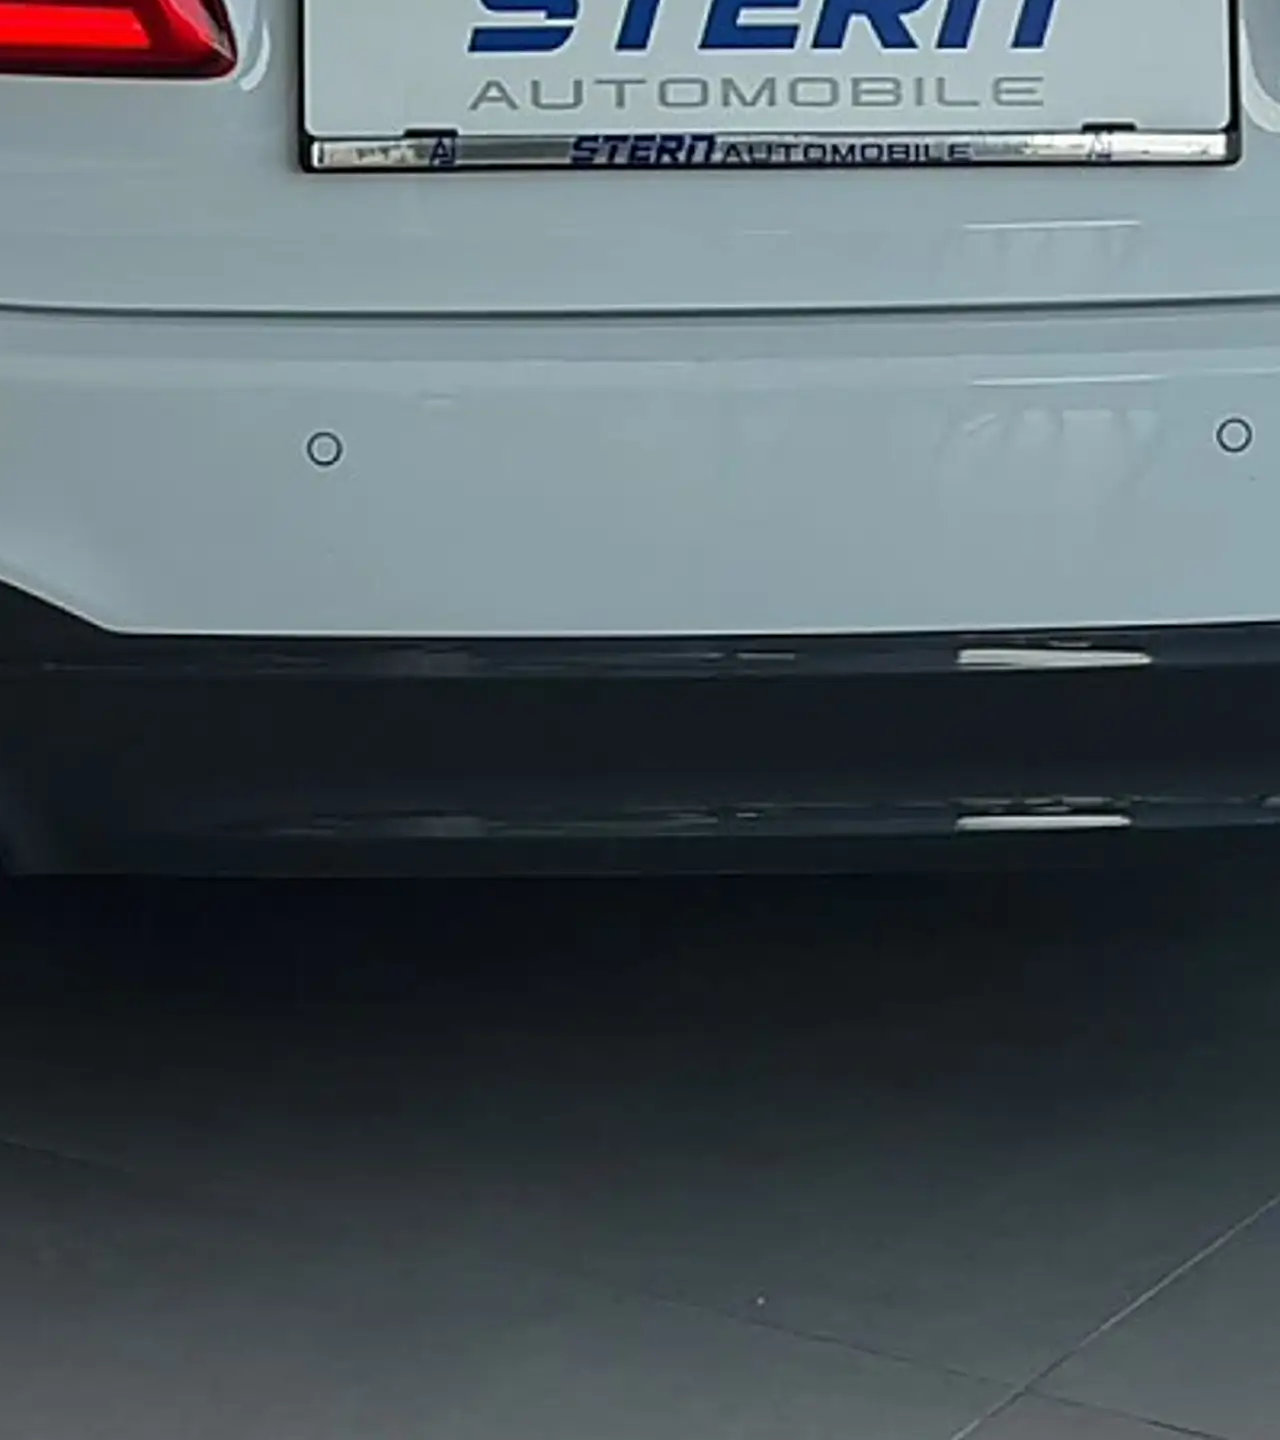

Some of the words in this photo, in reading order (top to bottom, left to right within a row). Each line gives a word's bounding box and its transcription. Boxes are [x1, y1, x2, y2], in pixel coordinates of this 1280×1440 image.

[468, 76, 1046, 112] AUTOMOBILE
[569, 133, 718, 164] STERN
[721, 142, 972, 162] AUTOMOBILE
